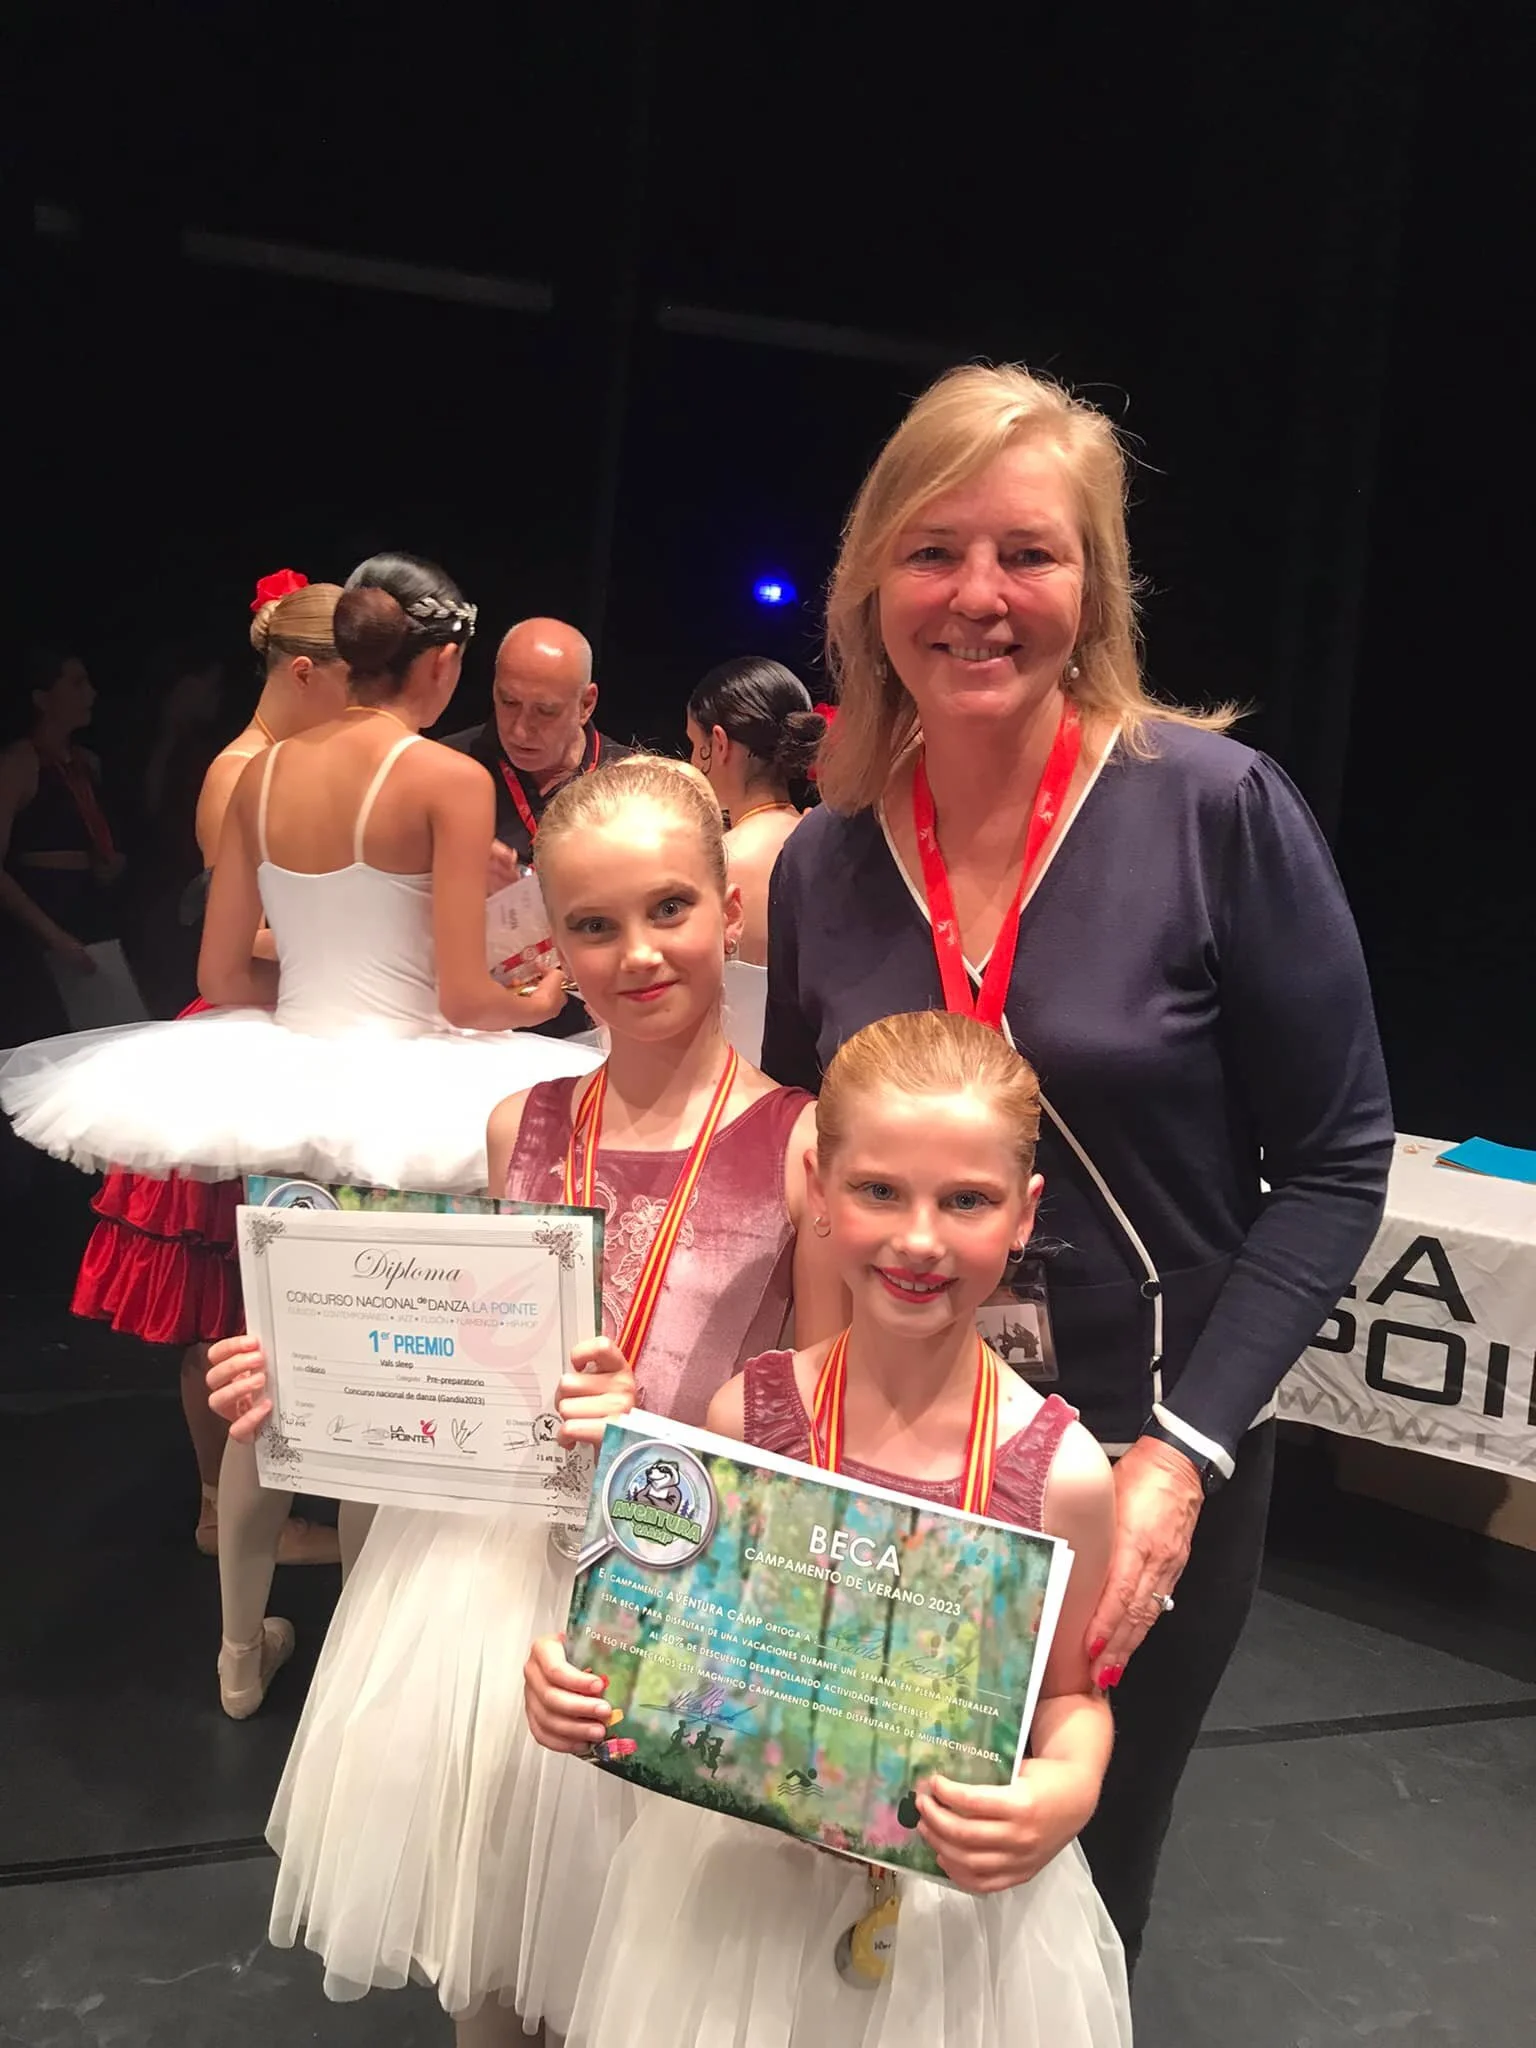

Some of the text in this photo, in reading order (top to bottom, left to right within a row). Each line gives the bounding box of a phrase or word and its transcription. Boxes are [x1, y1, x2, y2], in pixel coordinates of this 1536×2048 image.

[352, 1248, 463, 1290] Diploma
[1350, 1235, 1476, 1324] A
[287, 1290, 353, 1307] CONCURSO
[356, 1295, 418, 1311] NACIONAL
[428, 1299, 470, 1313] DANZA
[472, 1301, 487, 1314] LA
[491, 1302, 538, 1316] POINTE
[380, 1358, 414, 1370] Vals sleep
[394, 1333, 455, 1357] PREMIO
[1306, 1308, 1536, 1425] OI
[343, 1386, 375, 1398] Concurso
[376, 1390, 404, 1400] nacional
[405, 1391, 415, 1401] de
[416, 1392, 437, 1402] danza
[426, 1375, 485, 1388] Pre-preparatorio
[390, 1424, 405, 1433] LA
[390, 1433, 430, 1444] POINTE
[809, 1524, 901, 1576] BECA
[610, 1574, 664, 1599] CAMPAMENTO
[666, 1591, 724, 1617] AVENTURA
[727, 1609, 763, 1628] CAMP
[744, 1547, 962, 1616] CAMPAMENTO DE VERANO 2023
[620, 1598, 640, 1613] BECA
[642, 1606, 663, 1620] PARA
[665, 1614, 706, 1634] DISFRUTAR
[707, 1626, 718, 1638] DE
[720, 1631, 739, 1645] UNA
[742, 1637, 798, 1661] VACACIONES
[800, 1653, 838, 1673] DURANTE
[860, 1670, 898, 1690] SEMANA
[899, 1681, 912, 1693] EN
[914, 1685, 942, 1702] PLENA
[944, 1693, 1000, 1718] NATURALEZA
[661, 1631, 685, 1649] 40%
[687, 1642, 698, 1654] DE
[699, 1646, 748, 1668] DESCUENTO
[749, 1662, 822, 1690] DESARROLLANDO
[823, 1684, 880, 1707] ACTIVIDADES
[603, 1634, 618, 1648] ESO
[619, 1640, 628, 1652] TE
[629, 1645, 676, 1669] OFRECEMOS
[696, 1668, 747, 1690] MAGNIFICO
[748, 1683, 811, 1709] CAMPAMENTO
[811, 1702, 844, 1719] DONDE
[846, 1711, 902, 1736] DISFRUTARAS
[903, 1727, 916, 1739] DE
[917, 1732, 1003, 1764] MULTIACTIVIDADES.
